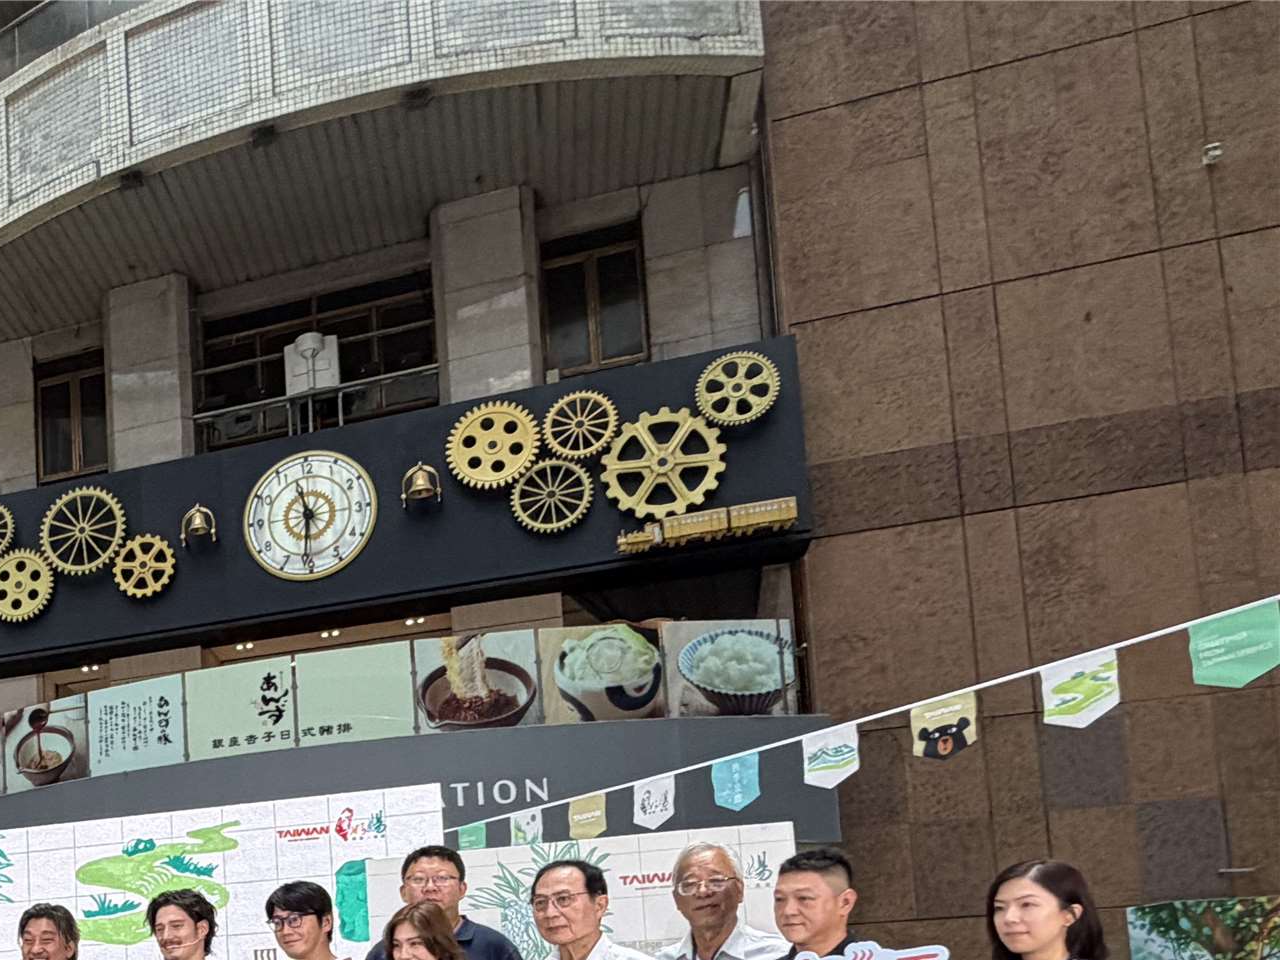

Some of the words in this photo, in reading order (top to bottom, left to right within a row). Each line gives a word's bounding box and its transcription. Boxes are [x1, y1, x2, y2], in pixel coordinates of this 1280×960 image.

[301, 462, 313, 475] 12
[346, 478, 354, 490] 2
[355, 501, 362, 512] 3
[257, 518, 264, 530] 9
[349, 526, 357, 537] 4
[264, 541, 272, 552] 8
[332, 546, 340, 558] 5
[442, 777, 549, 807] TION
[277, 825, 330, 838] TAIWAN
